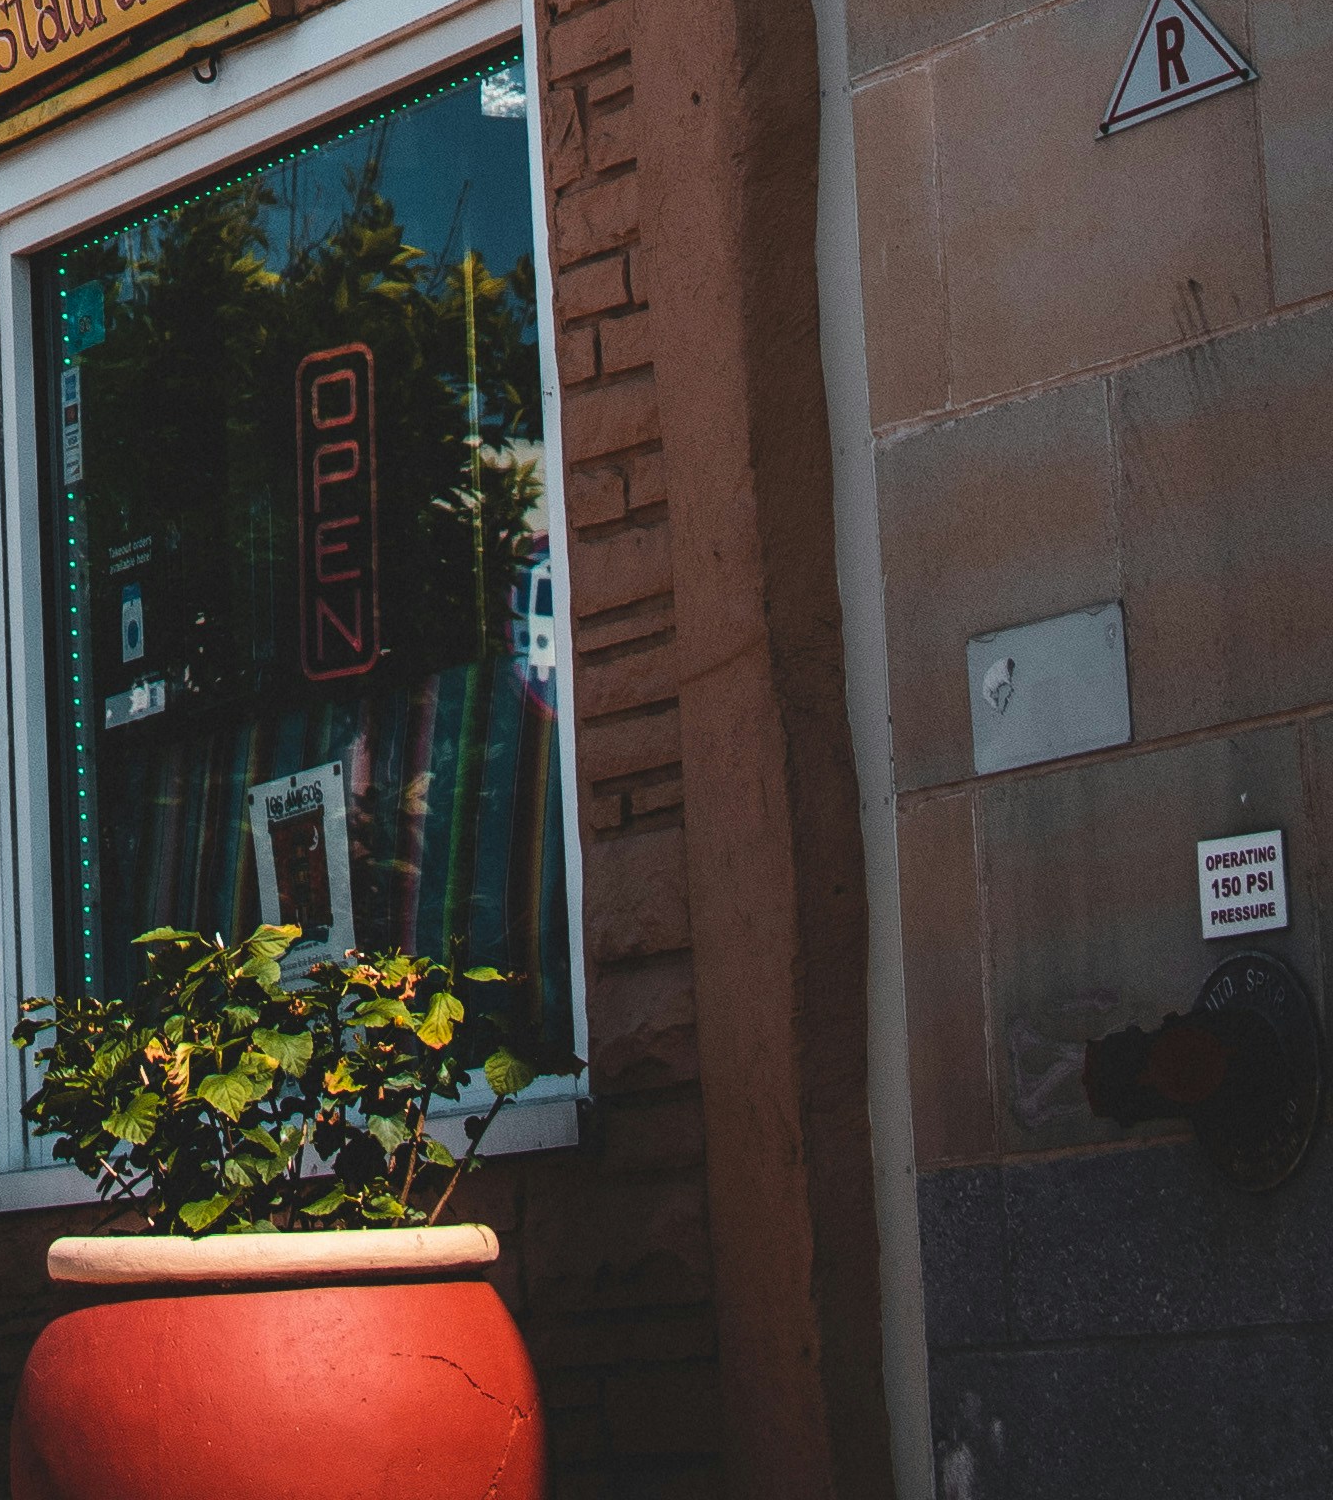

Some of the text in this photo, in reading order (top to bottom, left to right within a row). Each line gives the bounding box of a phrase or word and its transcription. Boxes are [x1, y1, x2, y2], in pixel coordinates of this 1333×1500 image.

[1154, 15, 1190, 93] R
[310, 368, 363, 661] OPEN
[1205, 845, 1277, 871] OPERATING
[1211, 870, 1274, 899] 150 PSI
[1210, 901, 1277, 925] PRESSURE
